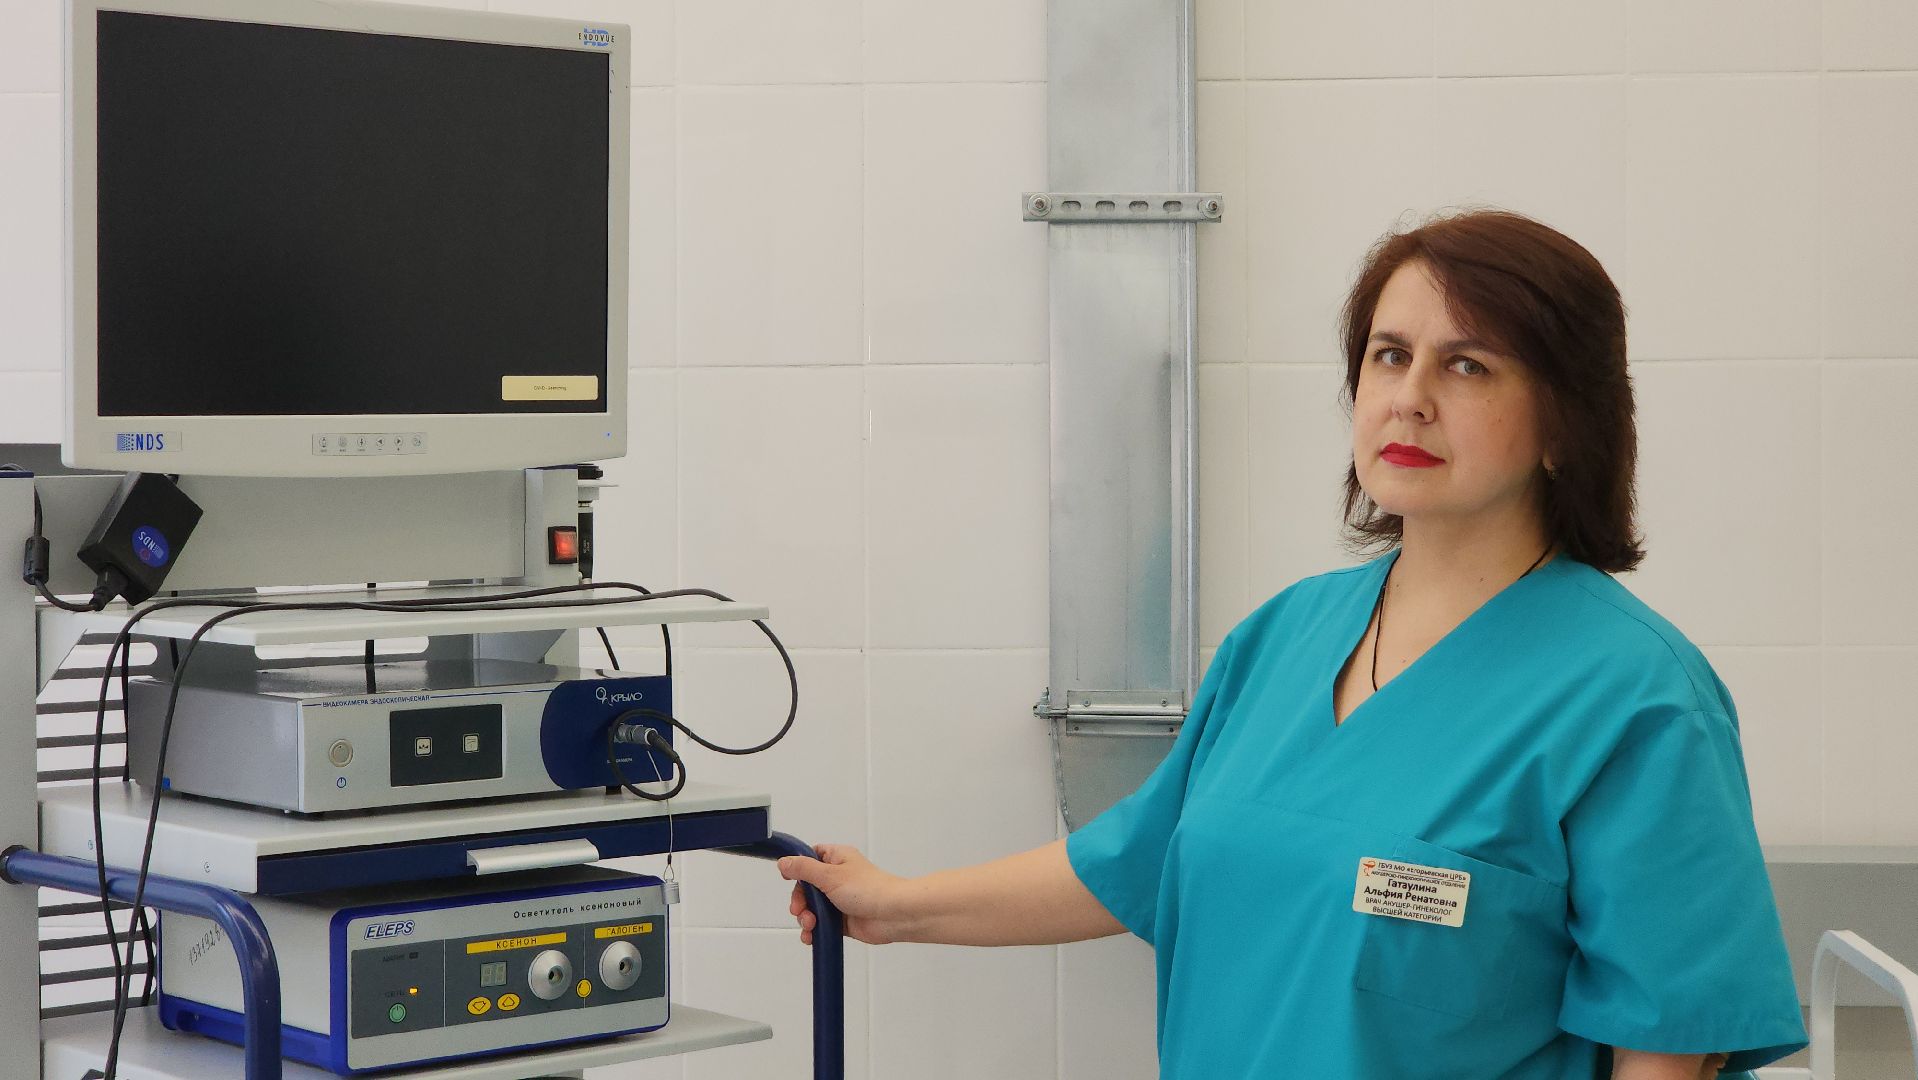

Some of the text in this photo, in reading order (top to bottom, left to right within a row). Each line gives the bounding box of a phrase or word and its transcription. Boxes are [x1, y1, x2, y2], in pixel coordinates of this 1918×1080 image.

[578, 32, 615, 43] ENDOVUE
[135, 433, 164, 451] NDS
[138, 531, 156, 551] NDS
[322, 695, 430, 708] ВИДЕОКАМЕРА ЭНДОСКОПИЧЕСКАЯ
[610, 692, 643, 703] КРЫЛО
[1378, 862, 1393, 870] ГБУЗ
[1394, 864, 1406, 872] МО
[1387, 878, 1438, 894] Гатаулина
[1364, 885, 1458, 908] Альфия Ренатовна
[513, 897, 642, 919] Осветитель ксеноновый
[1372, 905, 1442, 923] ВЫСШЕЙ КАТЕГОРИИ
[1382, 899, 1453, 916] АКУШЕР-ГИНЕКОЛОГ
[364, 920, 415, 940] ELEPS
[607, 925, 644, 936] ГАЛОГЕН
[496, 937, 538, 949] КСЕНОН
